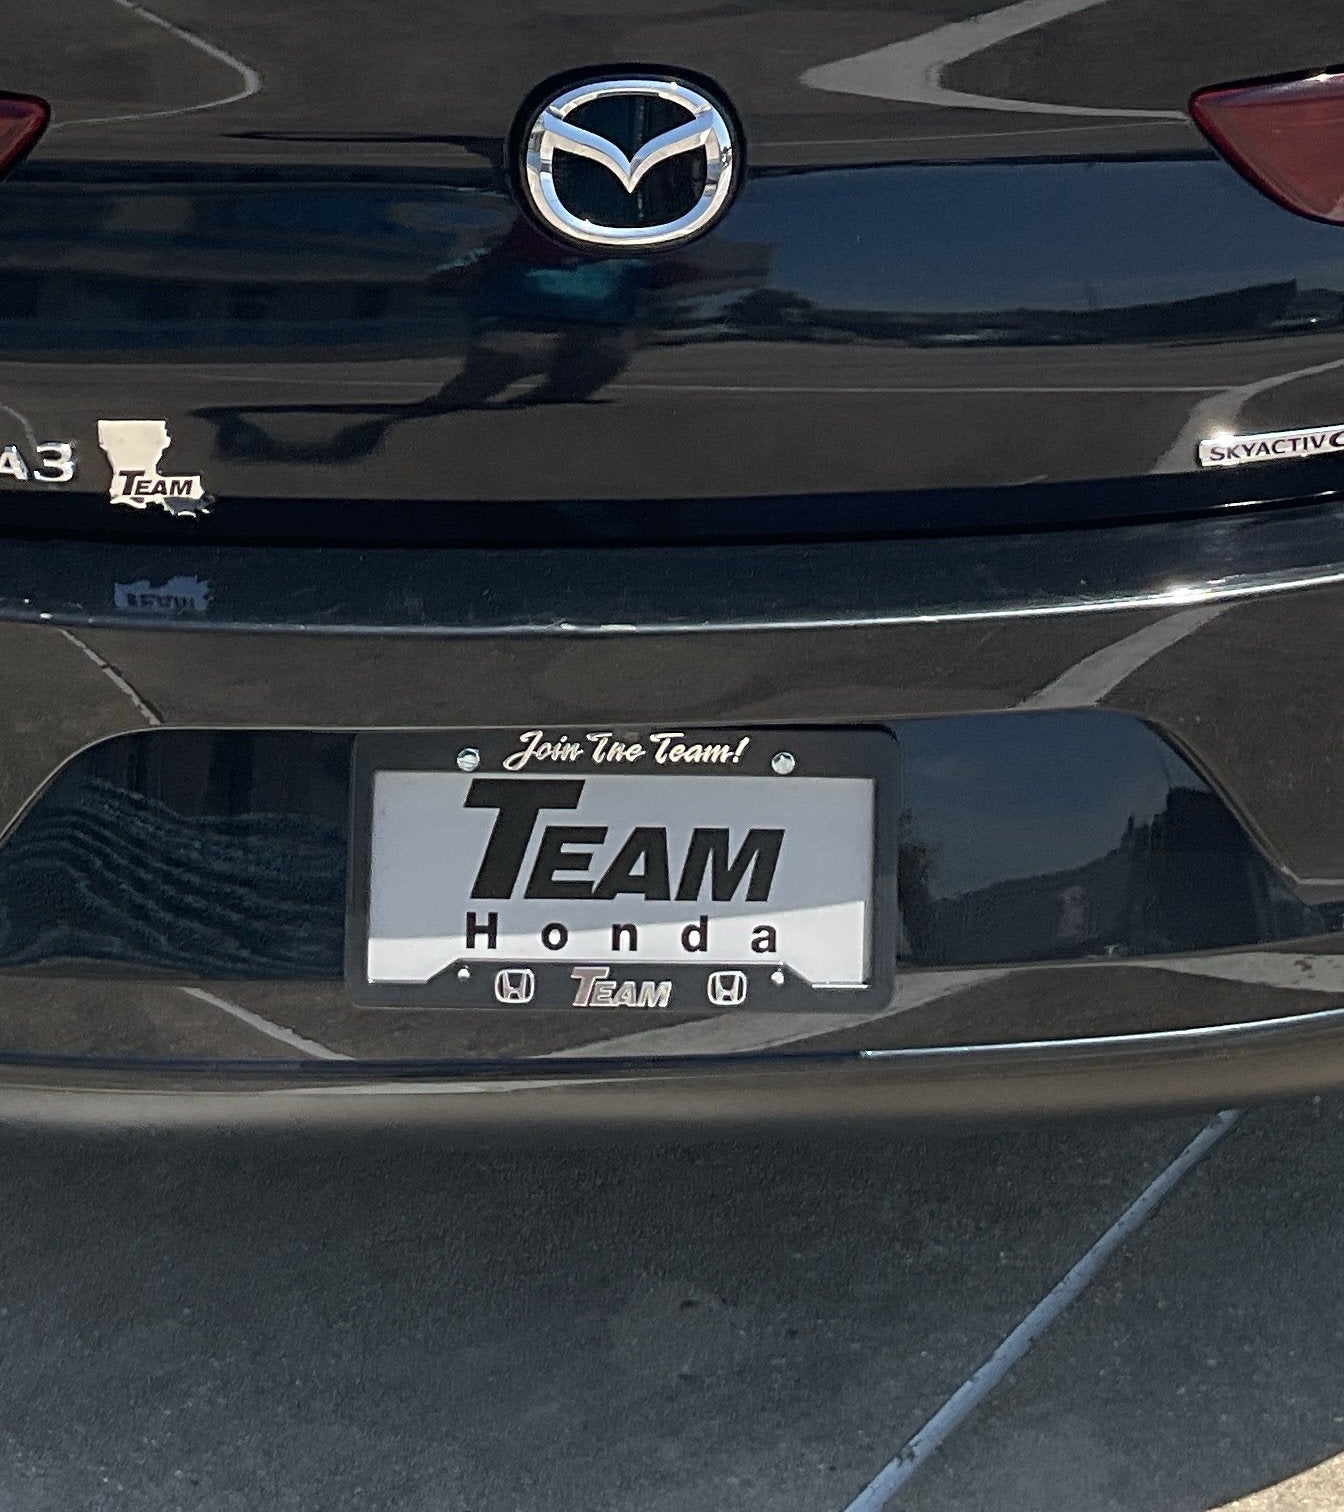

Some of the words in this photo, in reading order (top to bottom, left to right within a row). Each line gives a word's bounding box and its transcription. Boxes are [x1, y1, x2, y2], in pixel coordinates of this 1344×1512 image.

[118, 470, 193, 496] TEAM
[503, 730, 583, 771] Join
[650, 732, 749, 764] Team!
[463, 778, 786, 902] TEAM
[466, 911, 777, 953] Honda
[569, 966, 673, 1008] TEAM
